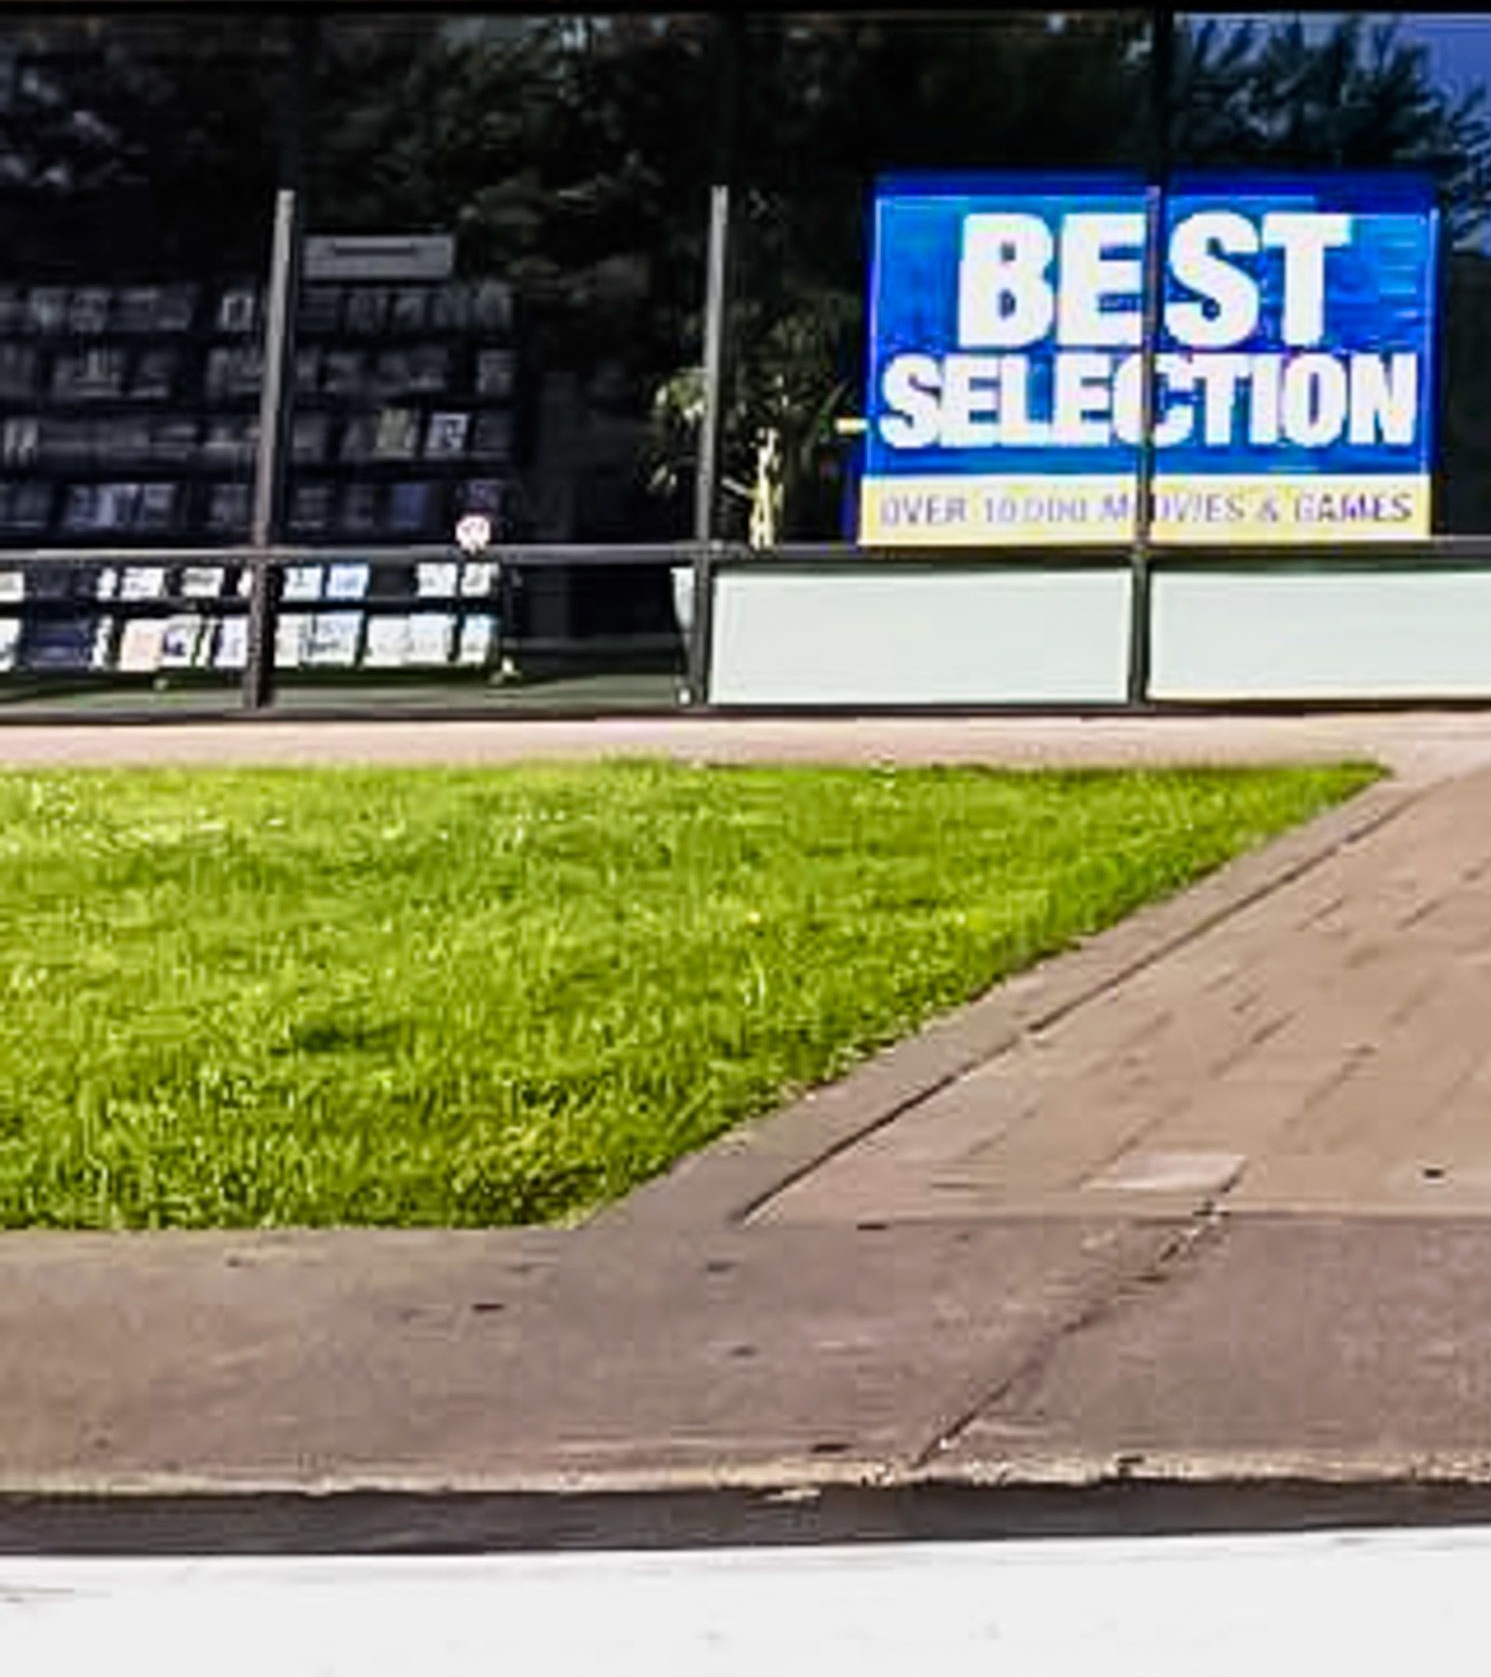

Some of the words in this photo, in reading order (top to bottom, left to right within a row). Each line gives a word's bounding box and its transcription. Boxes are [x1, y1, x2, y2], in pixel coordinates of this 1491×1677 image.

[957, 211, 1351, 348] BEST
[879, 353, 1417, 449] SELECTION
[880, 492, 966, 525] OVER
[1293, 491, 1413, 524] GAMES
